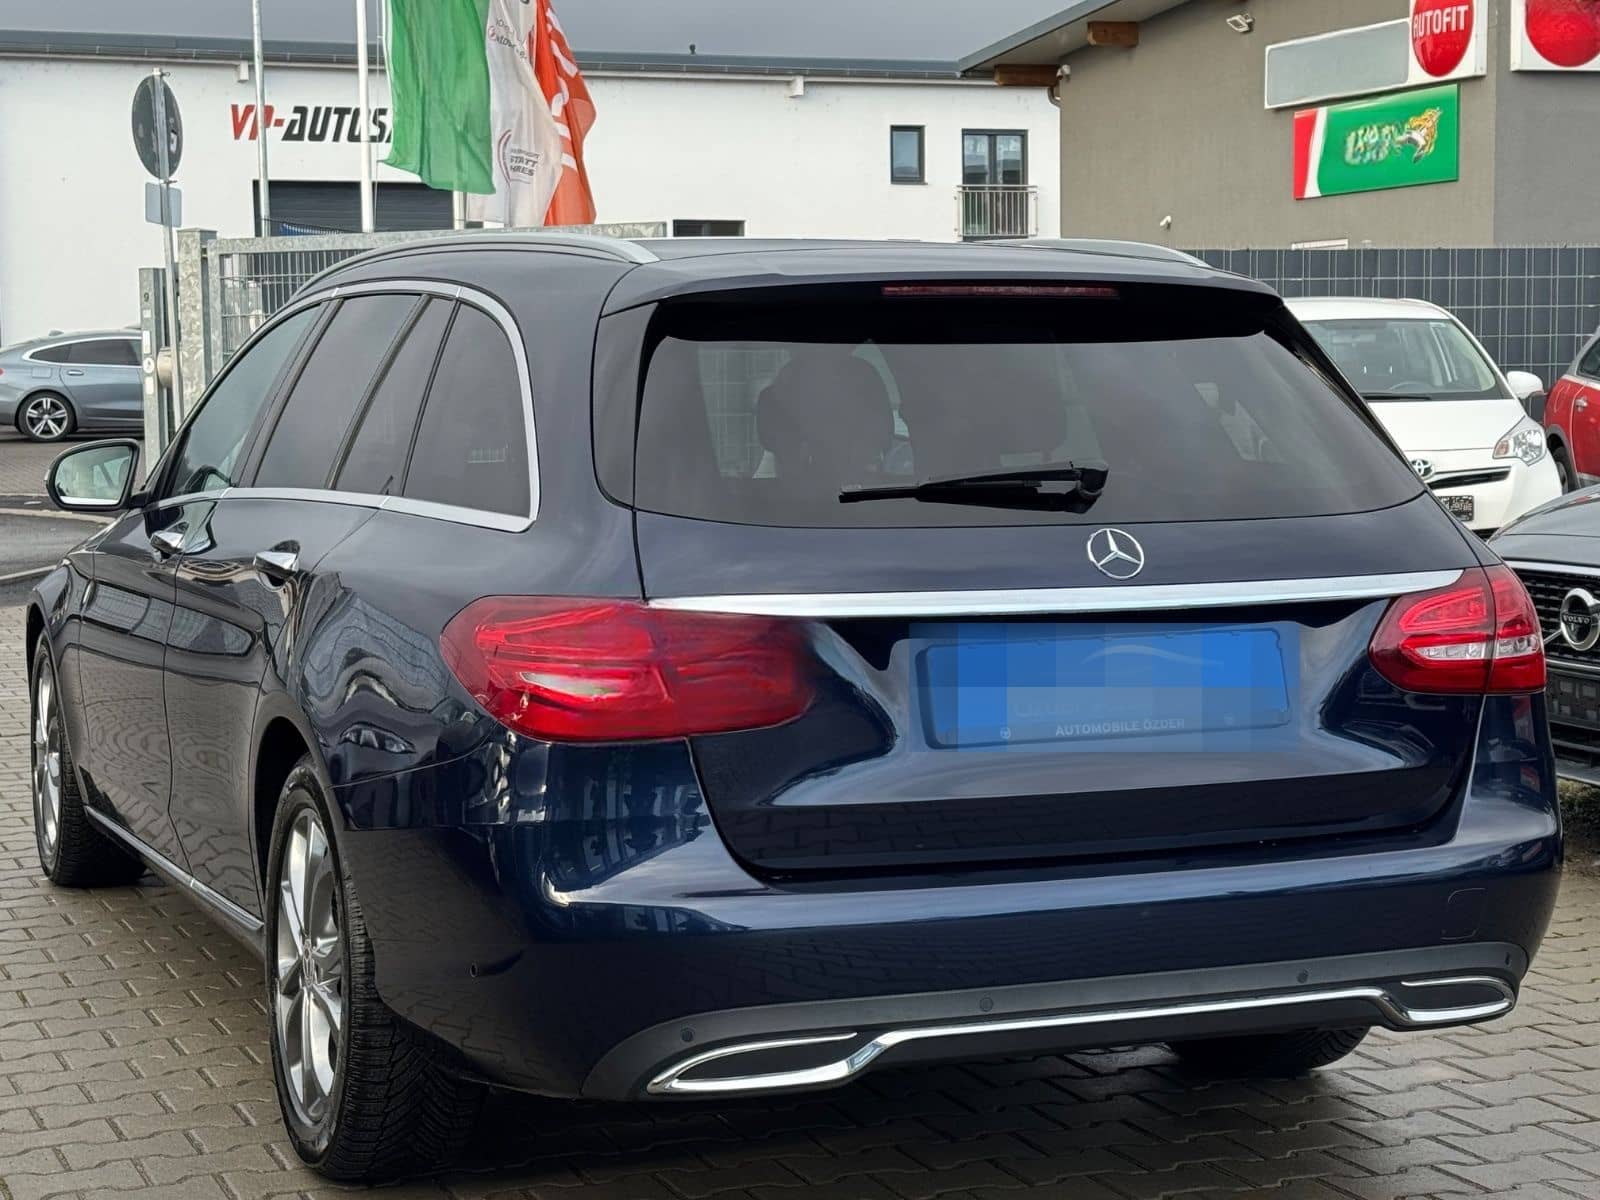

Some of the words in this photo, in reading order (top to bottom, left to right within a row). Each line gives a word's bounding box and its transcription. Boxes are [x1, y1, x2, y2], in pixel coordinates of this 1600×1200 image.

[1413, 5, 1469, 39] AUTOFIT
[231, 104, 392, 143] VP-AUTOS
[1562, 614, 1590, 625] VOLVO
[1055, 719, 1141, 737] AUTOMOBILE
[1143, 717, 1185, 731] ÖZDER
